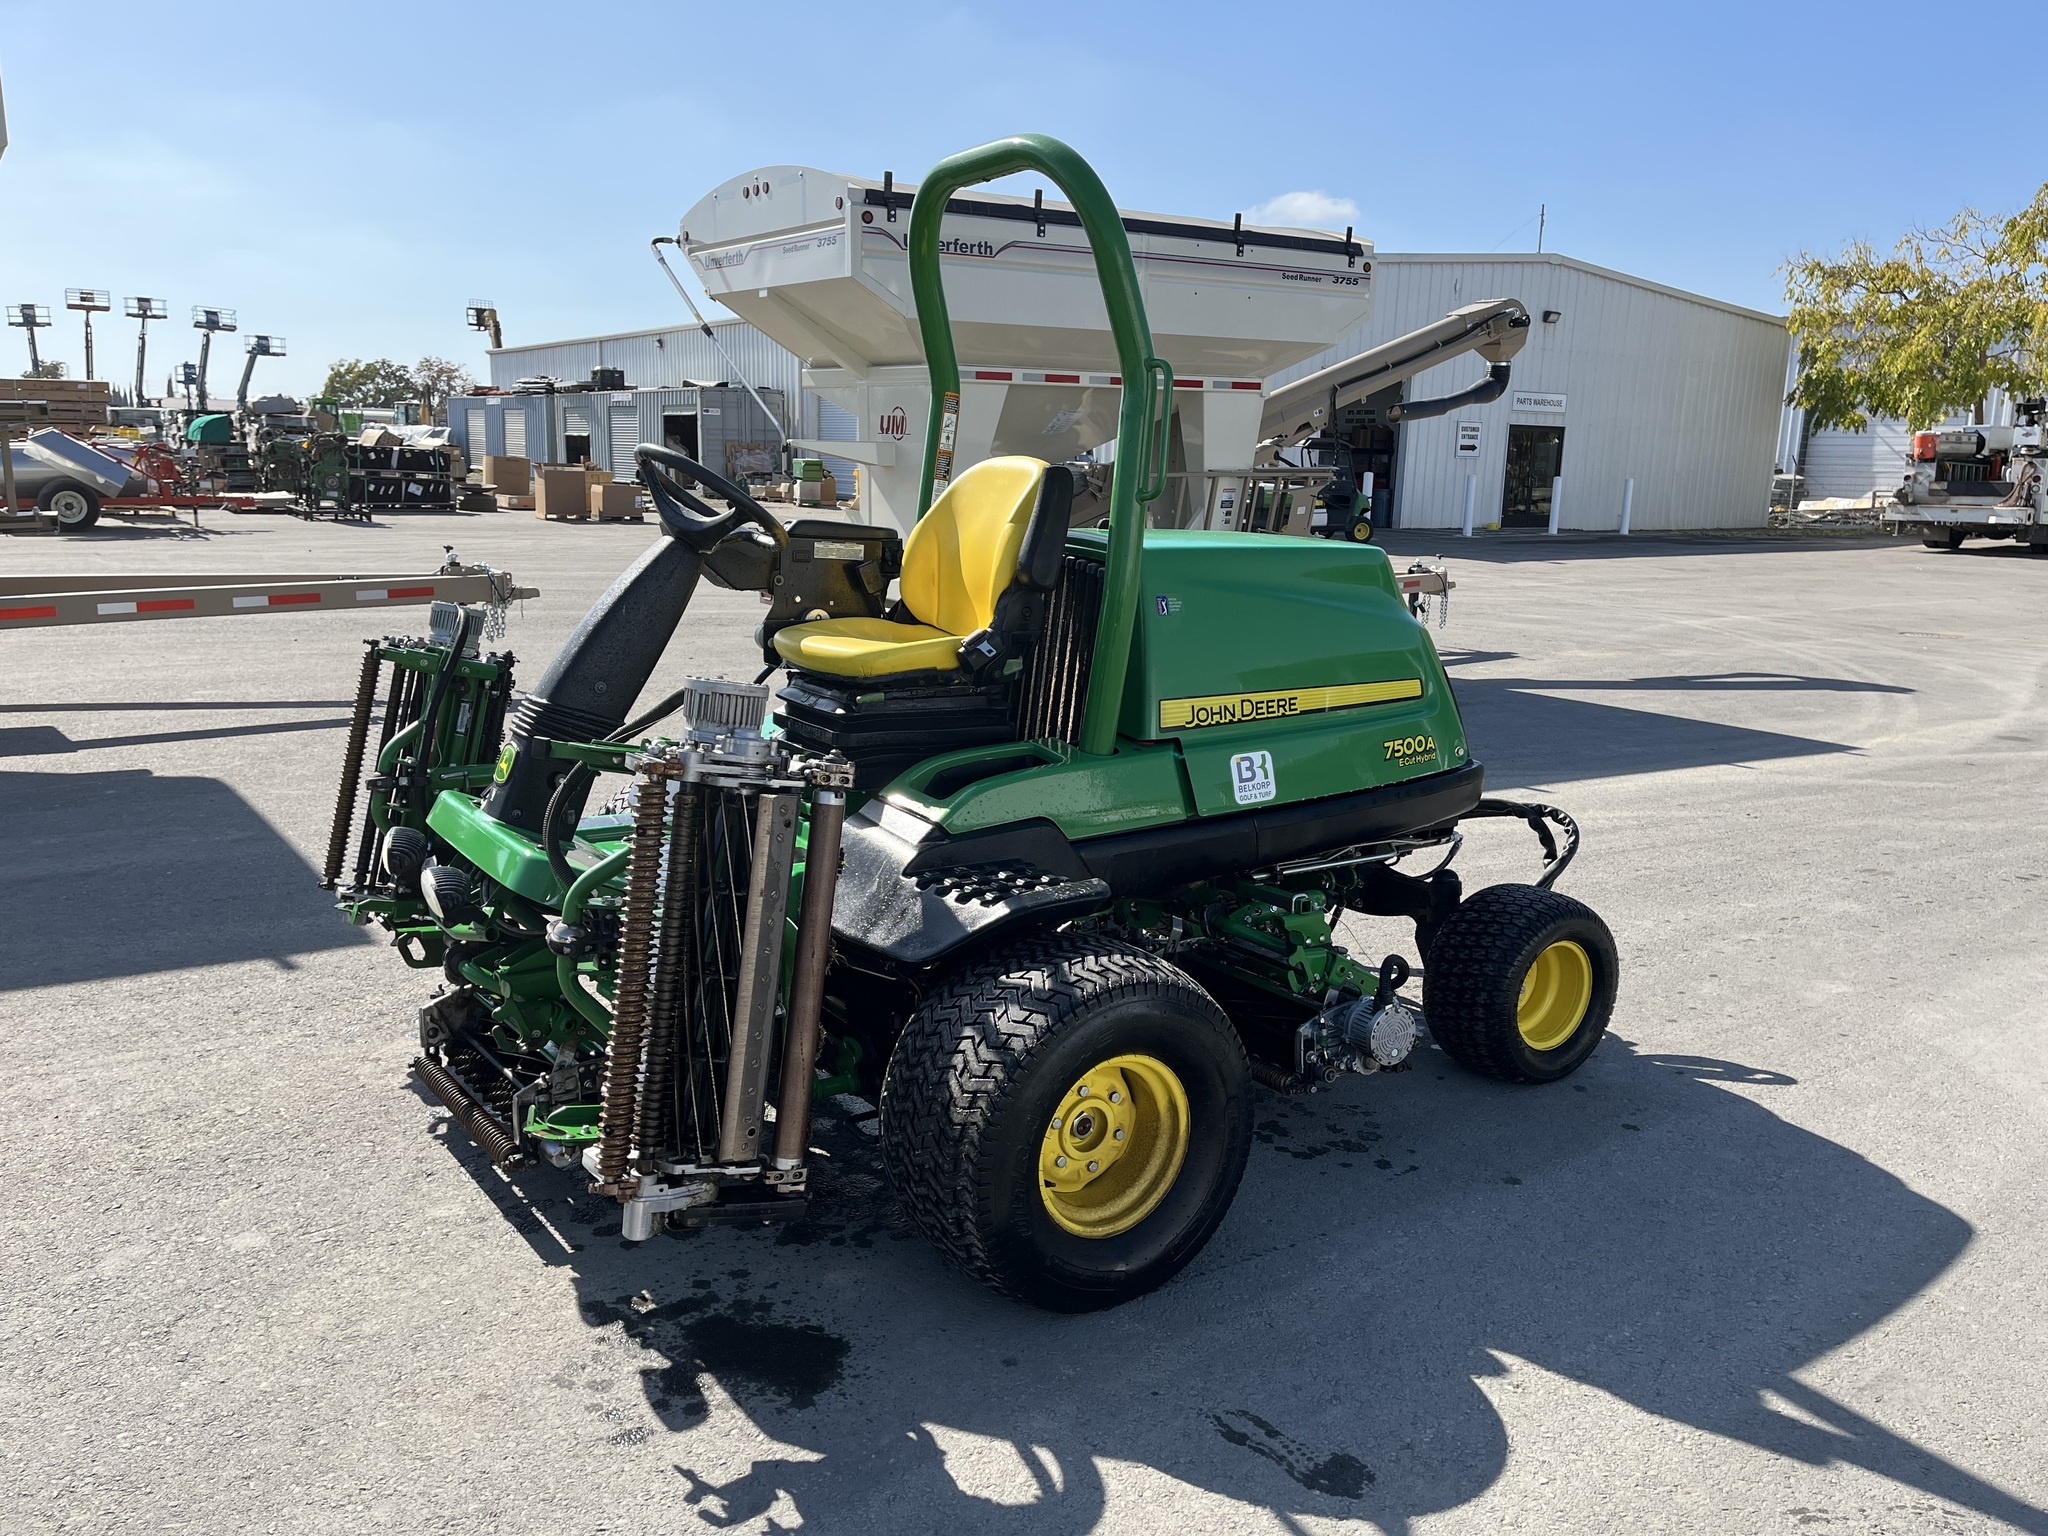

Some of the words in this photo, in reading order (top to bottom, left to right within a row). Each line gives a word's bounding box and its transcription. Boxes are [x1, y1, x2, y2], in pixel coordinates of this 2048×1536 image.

[817, 236, 837, 248] 3755
[1282, 272, 1298, 281] Seed
[1299, 274, 1322, 283] Runner
[1332, 276, 1360, 286] 3755
[1516, 397, 1532, 406] PARTS
[1533, 398, 1563, 408] WAREHOUSE
[1184, 703, 1236, 725] JOHN
[1240, 696, 1299, 719] DEERE
[1384, 735, 1436, 760] 7500A
[1416, 752, 1436, 764] Hybrid
[1238, 781, 1271, 793] BELKORP
[1240, 793, 1253, 801] GOLF
[1258, 791, 1272, 799] TURF
